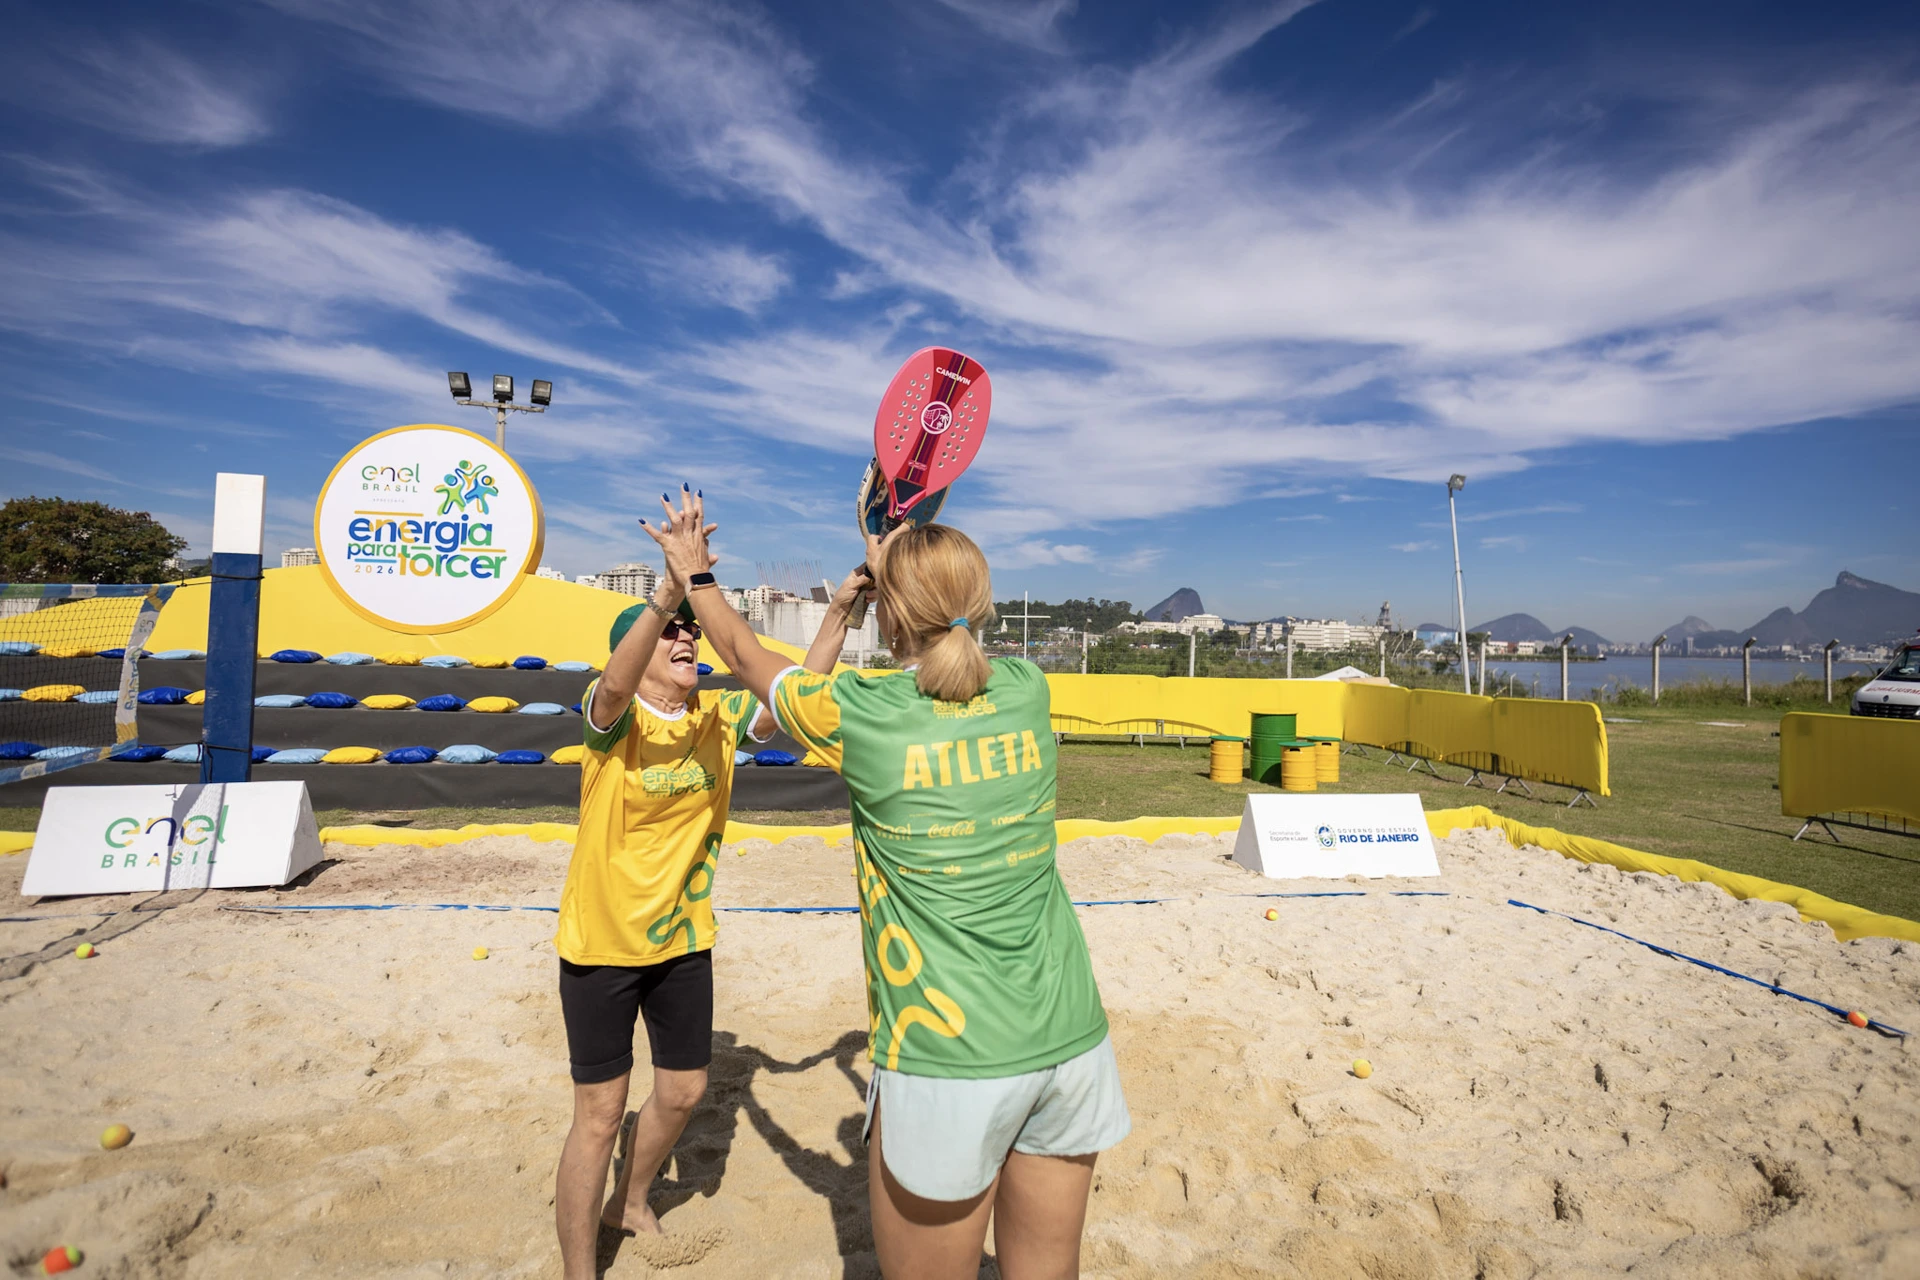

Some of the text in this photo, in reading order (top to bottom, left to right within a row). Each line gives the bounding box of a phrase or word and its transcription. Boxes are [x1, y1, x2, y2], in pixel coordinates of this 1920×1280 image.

[936, 366, 971, 385] CAMEWIN
[361, 463, 421, 483] enel
[362, 482, 418, 493] BRASIL
[348, 513, 492, 553] energia
[347, 542, 507, 579] para torcer
[354, 564, 394, 574] 2026
[902, 729, 1043, 790] ATLETA
[668, 776, 716, 798] torcer
[105, 804, 229, 849] enel
[1339, 834, 1419, 843] RIO DE JANEIRO
[100, 851, 218, 869] BRASIL
